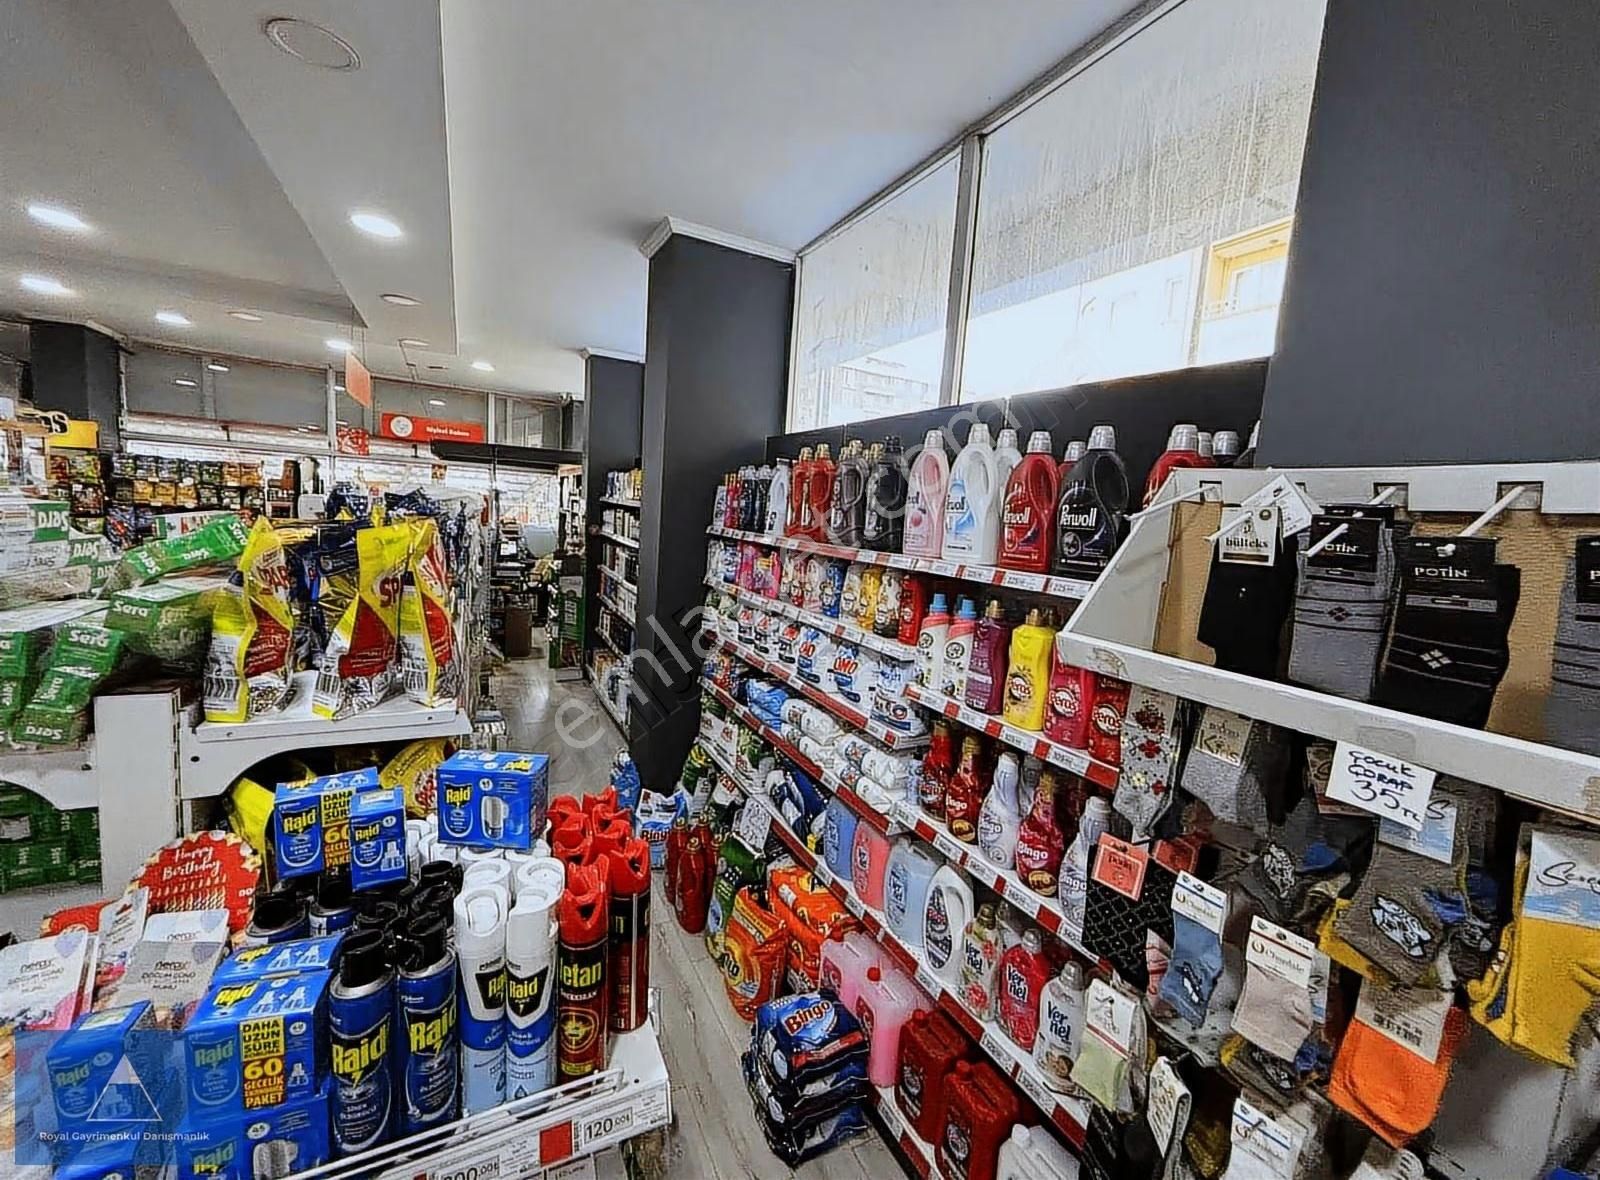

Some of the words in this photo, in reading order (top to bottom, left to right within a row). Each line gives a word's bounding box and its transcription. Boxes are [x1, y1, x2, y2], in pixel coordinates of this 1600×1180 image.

[1060, 503, 1097, 527] Perwoll
[1226, 536, 1268, 549] bülteks
[1414, 564, 1468, 578] POTİN
[112, 600, 148, 618] Sera
[25, 724, 63, 740] Sera
[446, 786, 471, 804] Raid
[284, 808, 317, 834] Raid
[355, 824, 380, 841] Raid
[560, 956, 602, 988] etan
[214, 984, 257, 1005] Raid
[783, 999, 833, 1037] Bingo
[1047, 1000, 1069, 1023] Ver
[242, 1020, 280, 1034] DAHA
[243, 1029, 280, 1043] UZUN
[1049, 1018, 1072, 1041] nel
[194, 1041, 234, 1066] Raid
[244, 1039, 280, 1054] SÜRE
[332, 1022, 387, 1075] Raid
[55, 1064, 90, 1087] Raid
[244, 1057, 283, 1080] 60
[246, 1092, 284, 1109] PAKET
